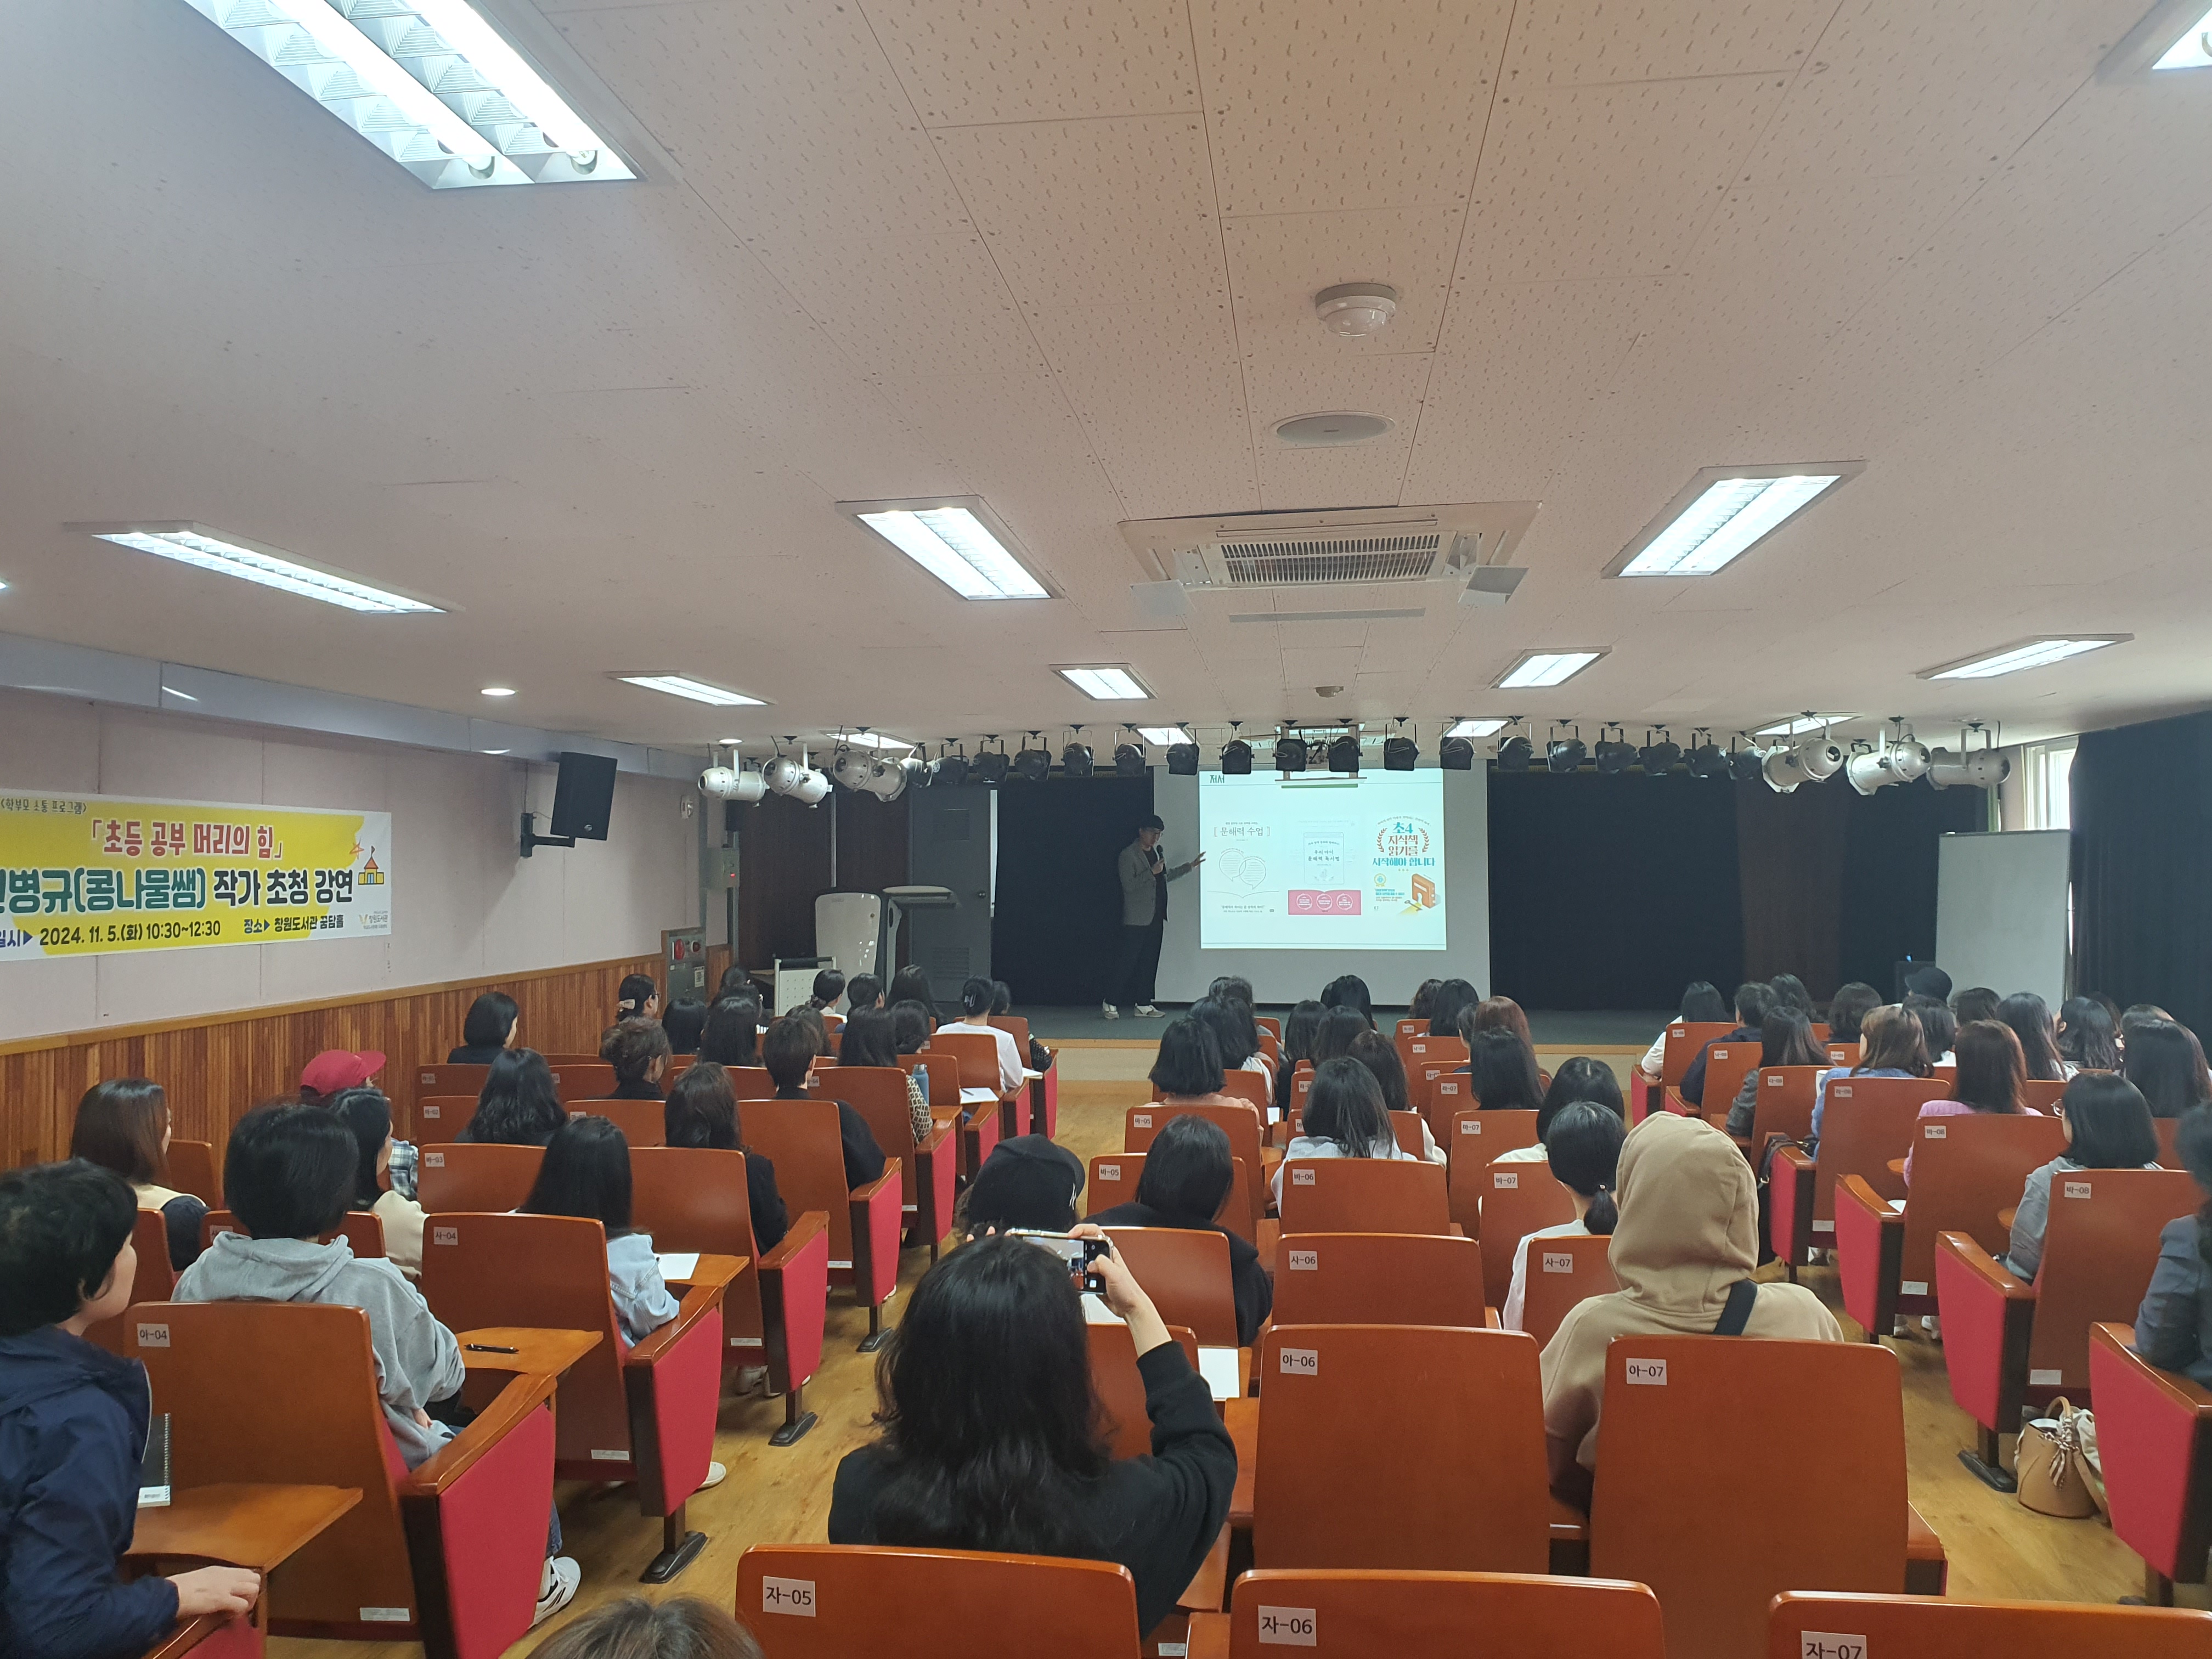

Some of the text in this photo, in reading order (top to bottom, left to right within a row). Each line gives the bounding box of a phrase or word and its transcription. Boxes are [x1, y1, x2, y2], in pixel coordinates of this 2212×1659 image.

[1210, 775, 1224, 783] 저서
[34, 800, 48, 813] 소통
[1220, 826, 1263, 836] 문해력 수업
[1392, 822, 1413, 834] 초4
[151, 822, 185, 856] 공부
[194, 824, 250, 854] 머리의
[1388, 835, 1418, 845] 지식책
[1388, 846, 1418, 856] 읽기를
[1372, 857, 1435, 866] 시작해야 합니다
[214, 870, 261, 906] 작가
[267, 870, 308, 904] 초청
[315, 870, 353, 903] 강연
[40, 927, 84, 946] 2024.
[89, 926, 103, 943] 11.
[107, 923, 143, 942] 5.(화)
[146, 920, 221, 940] 10:30~12:30
[244, 918, 262, 934] 장소
[275, 916, 318, 932] 창원도서관
[320, 915, 344, 929] 꿈담홀
[1291, 1256, 1315, 1265] 사-06
[1545, 1258, 1570, 1267] 사-07
[140, 1330, 167, 1340] 아-04
[1283, 1355, 1315, 1367] 아-06
[1629, 1365, 1663, 1377] 아-07
[766, 1586, 811, 1606] 자-05
[1262, 1617, 1312, 1635] 자-06
[1807, 1643, 1861, 1659] 자-07
